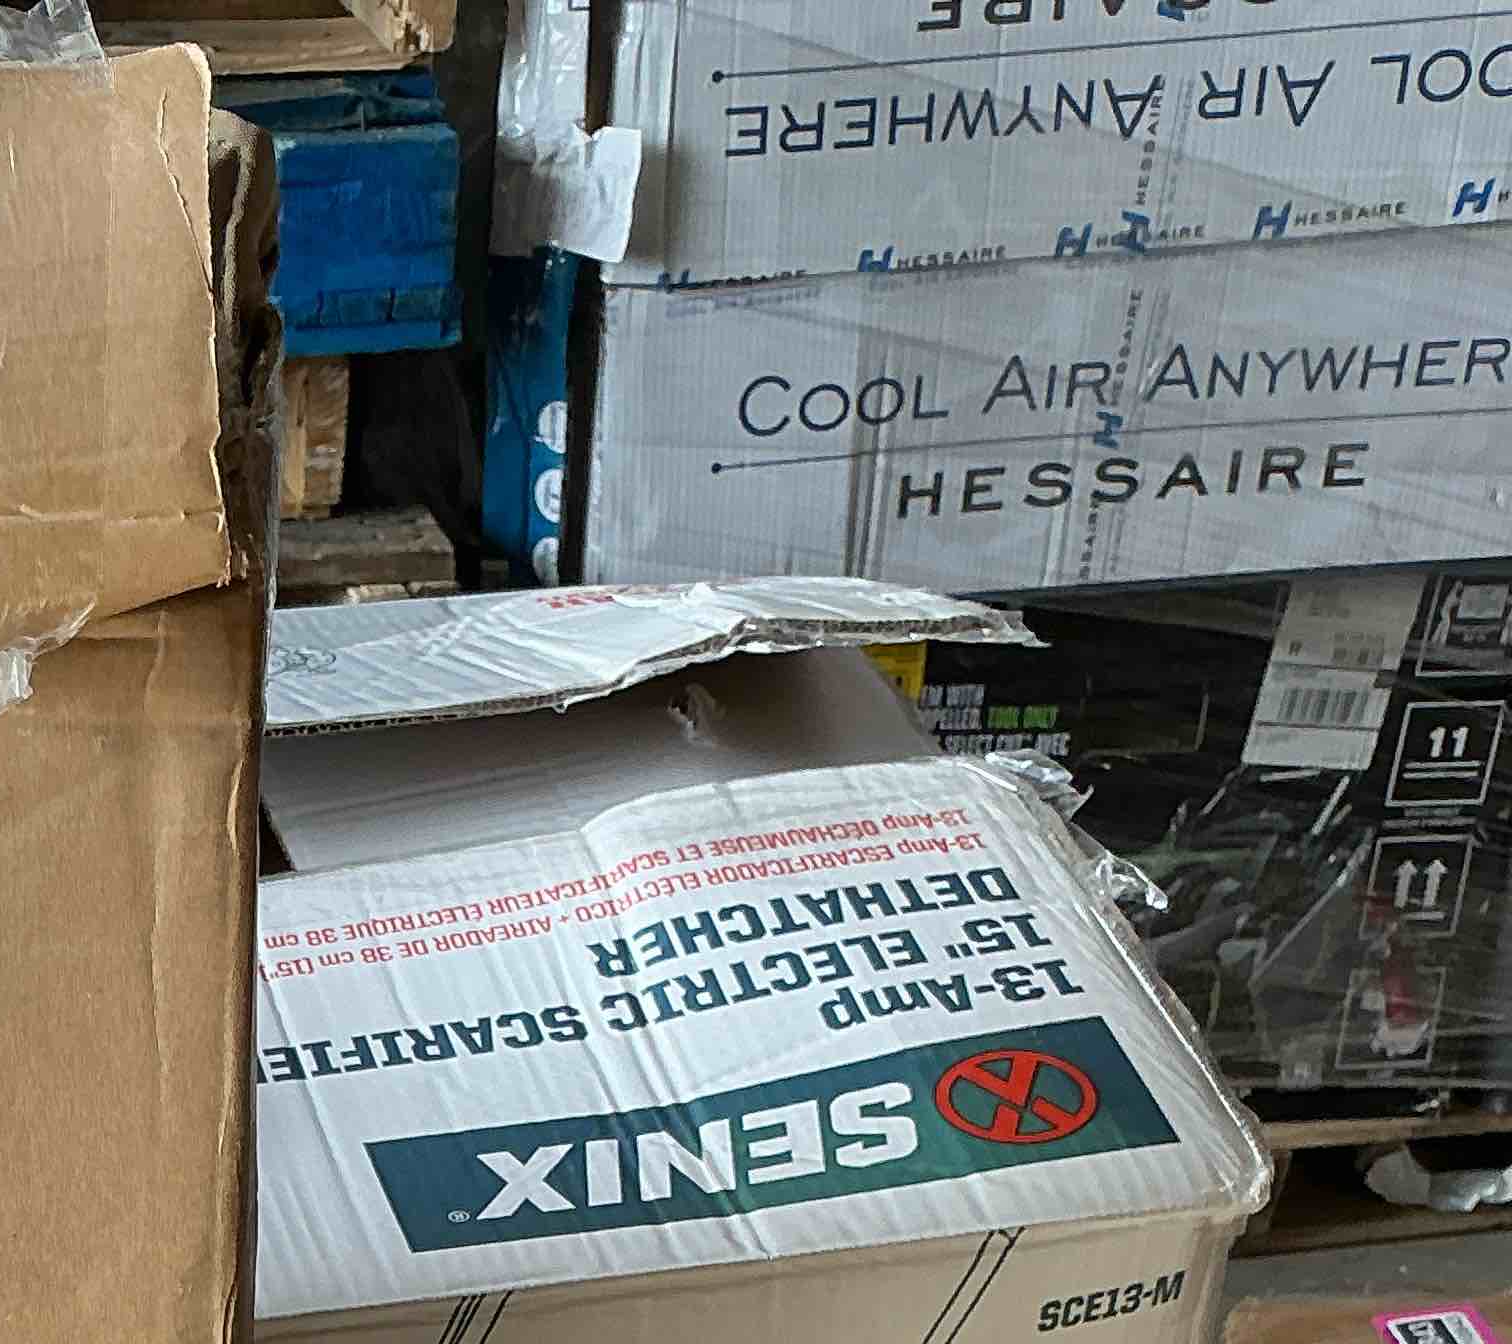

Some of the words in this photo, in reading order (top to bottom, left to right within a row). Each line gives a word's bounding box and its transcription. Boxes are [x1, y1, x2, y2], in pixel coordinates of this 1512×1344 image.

[1198, 60, 1336, 127] AIR
[1370, 42, 1512, 105] OOL
[726, 75, 1165, 157] ANYWHERE
[1294, 201, 1406, 227] HESSAIRE
[738, 376, 950, 437] COOL
[982, 355, 1107, 414] AIR
[1143, 338, 1512, 402] ANYWHER
[898, 443, 1369, 519] HESSAIRE
[711, 820, 879, 858] DÉCHAUMEUSE
[884, 807, 969, 830] 13-Amp
[676, 844, 704, 862] ET
[707, 846, 895, 886] ESCARIFICADOR
[897, 832, 987, 858] 13-Amp
[488, 849, 670, 914] SCARIFICATEUR
[264, 933, 299, 949] cm
[305, 927, 340, 947] 38
[436, 915, 552, 953] AIREADOR
[586, 866, 1021, 978] DETHATCHER
[944, 912, 1052, 959] 15"
[318, 951, 355, 966] cm
[360, 946, 393, 964] 38
[400, 942, 430, 957] DE
[600, 930, 928, 1032] ELECTRIC
[820, 959, 1085, 1030] 13-Amp
[476, 1081, 918, 1220] SENIX
[1038, 1271, 1186, 1332] SCE13-M
